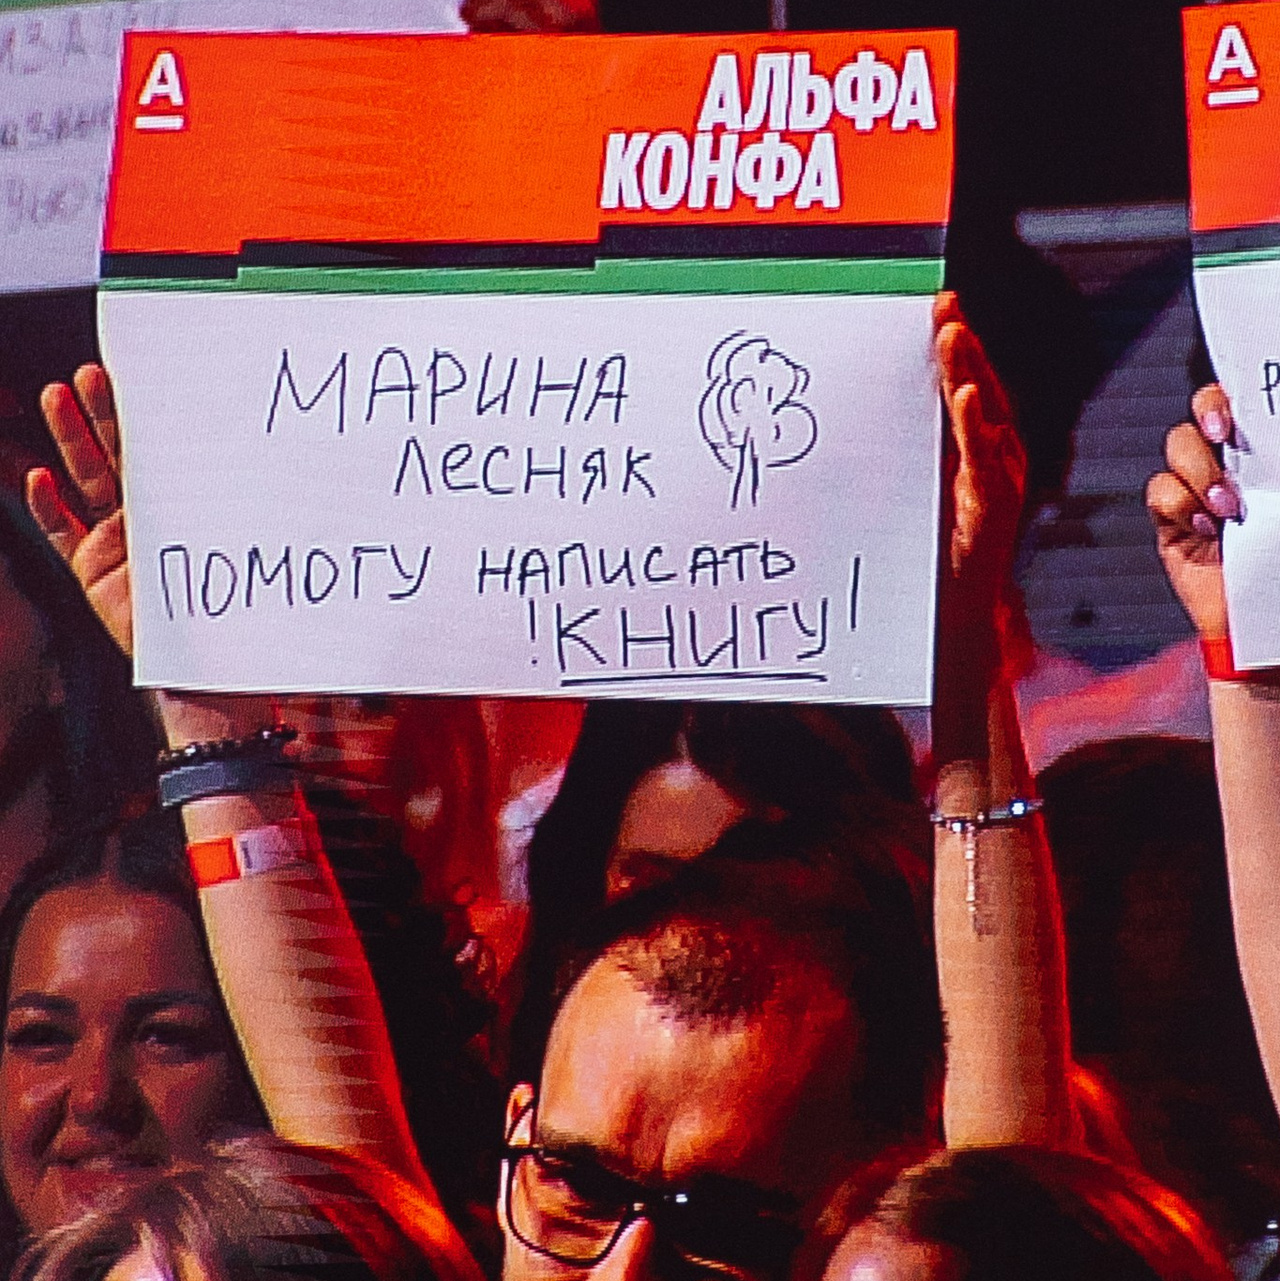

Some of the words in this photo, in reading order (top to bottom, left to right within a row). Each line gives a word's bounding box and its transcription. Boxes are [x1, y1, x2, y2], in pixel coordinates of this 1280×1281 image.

[698, 50, 937, 133] АЛЬФА
[601, 132, 841, 210] КОНФА
[264, 346, 630, 434] МАРИНА
[158, 543, 432, 623] ПОМОГУ
[478, 543, 796, 597] НАПИСАТЬ
